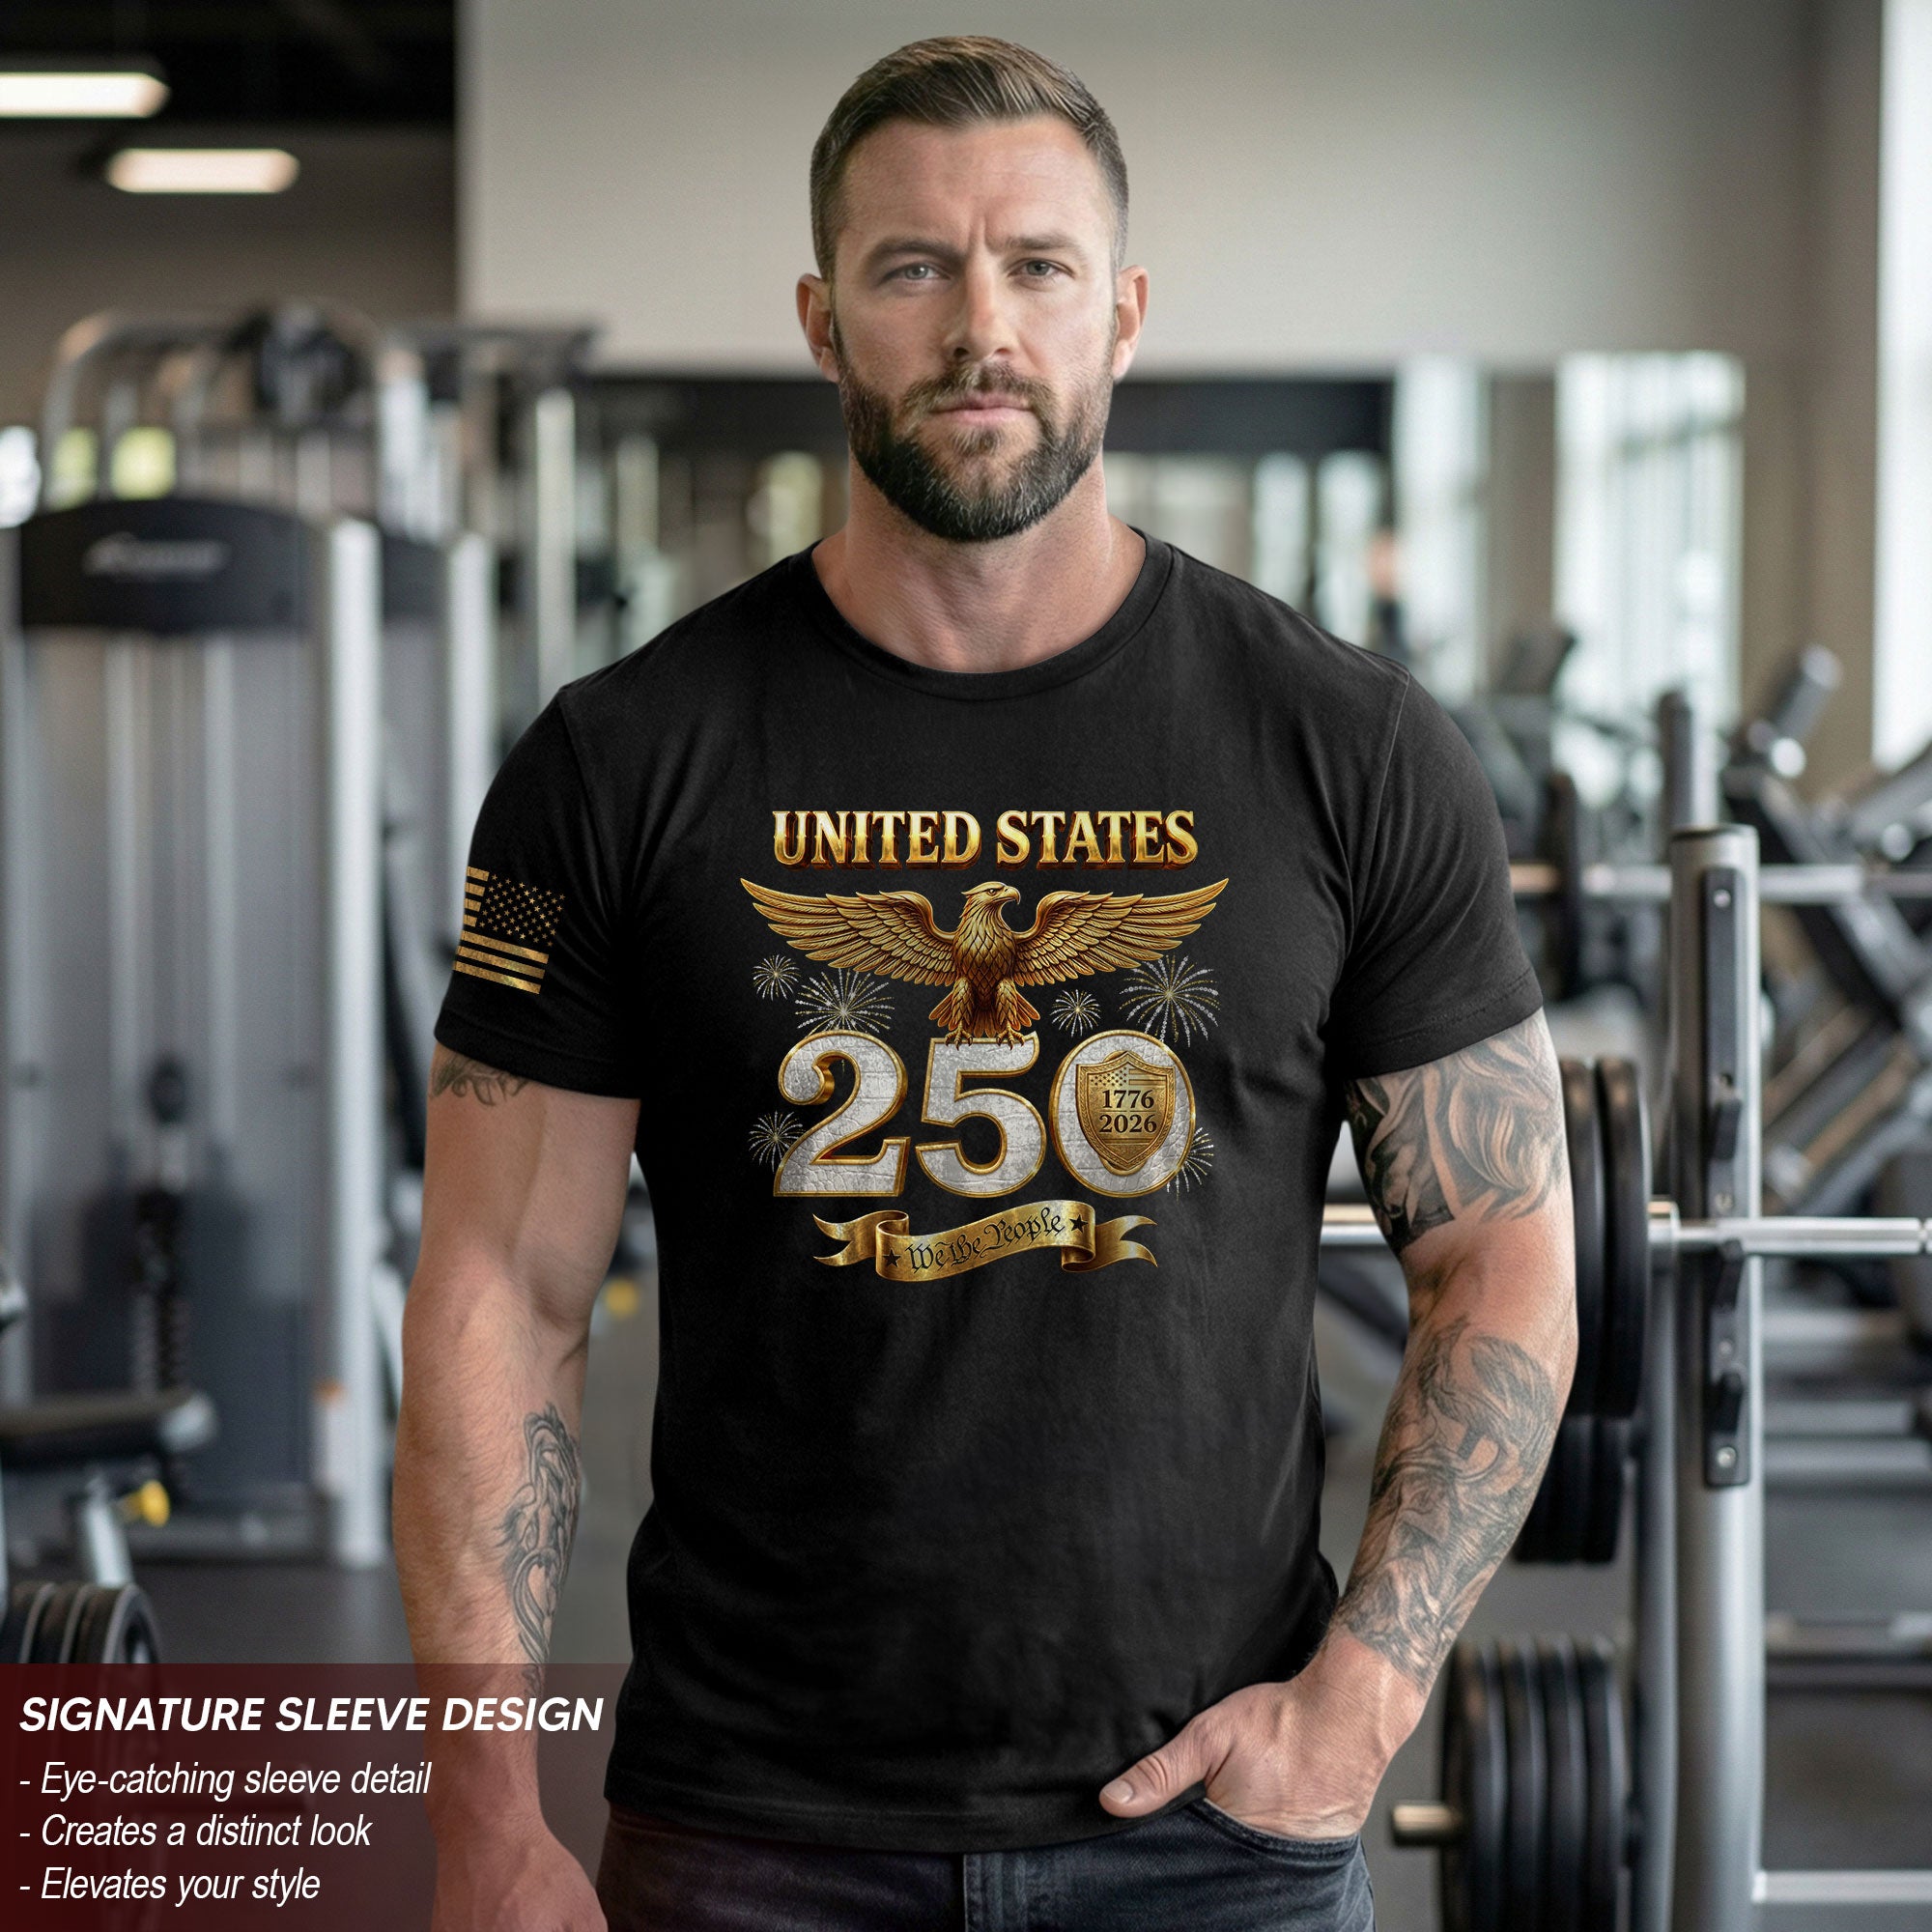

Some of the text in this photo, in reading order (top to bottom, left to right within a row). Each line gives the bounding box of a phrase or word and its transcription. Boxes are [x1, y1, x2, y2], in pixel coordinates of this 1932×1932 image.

[772, 810, 1199, 869] UNITED STATES
[773, 1030, 1196, 1199] 250
[1098, 1114, 1157, 1134] 2026
[1101, 1089, 1155, 1110] 1776
[905, 1243, 951, 1273] We
[980, 1207, 1065, 1259] People
